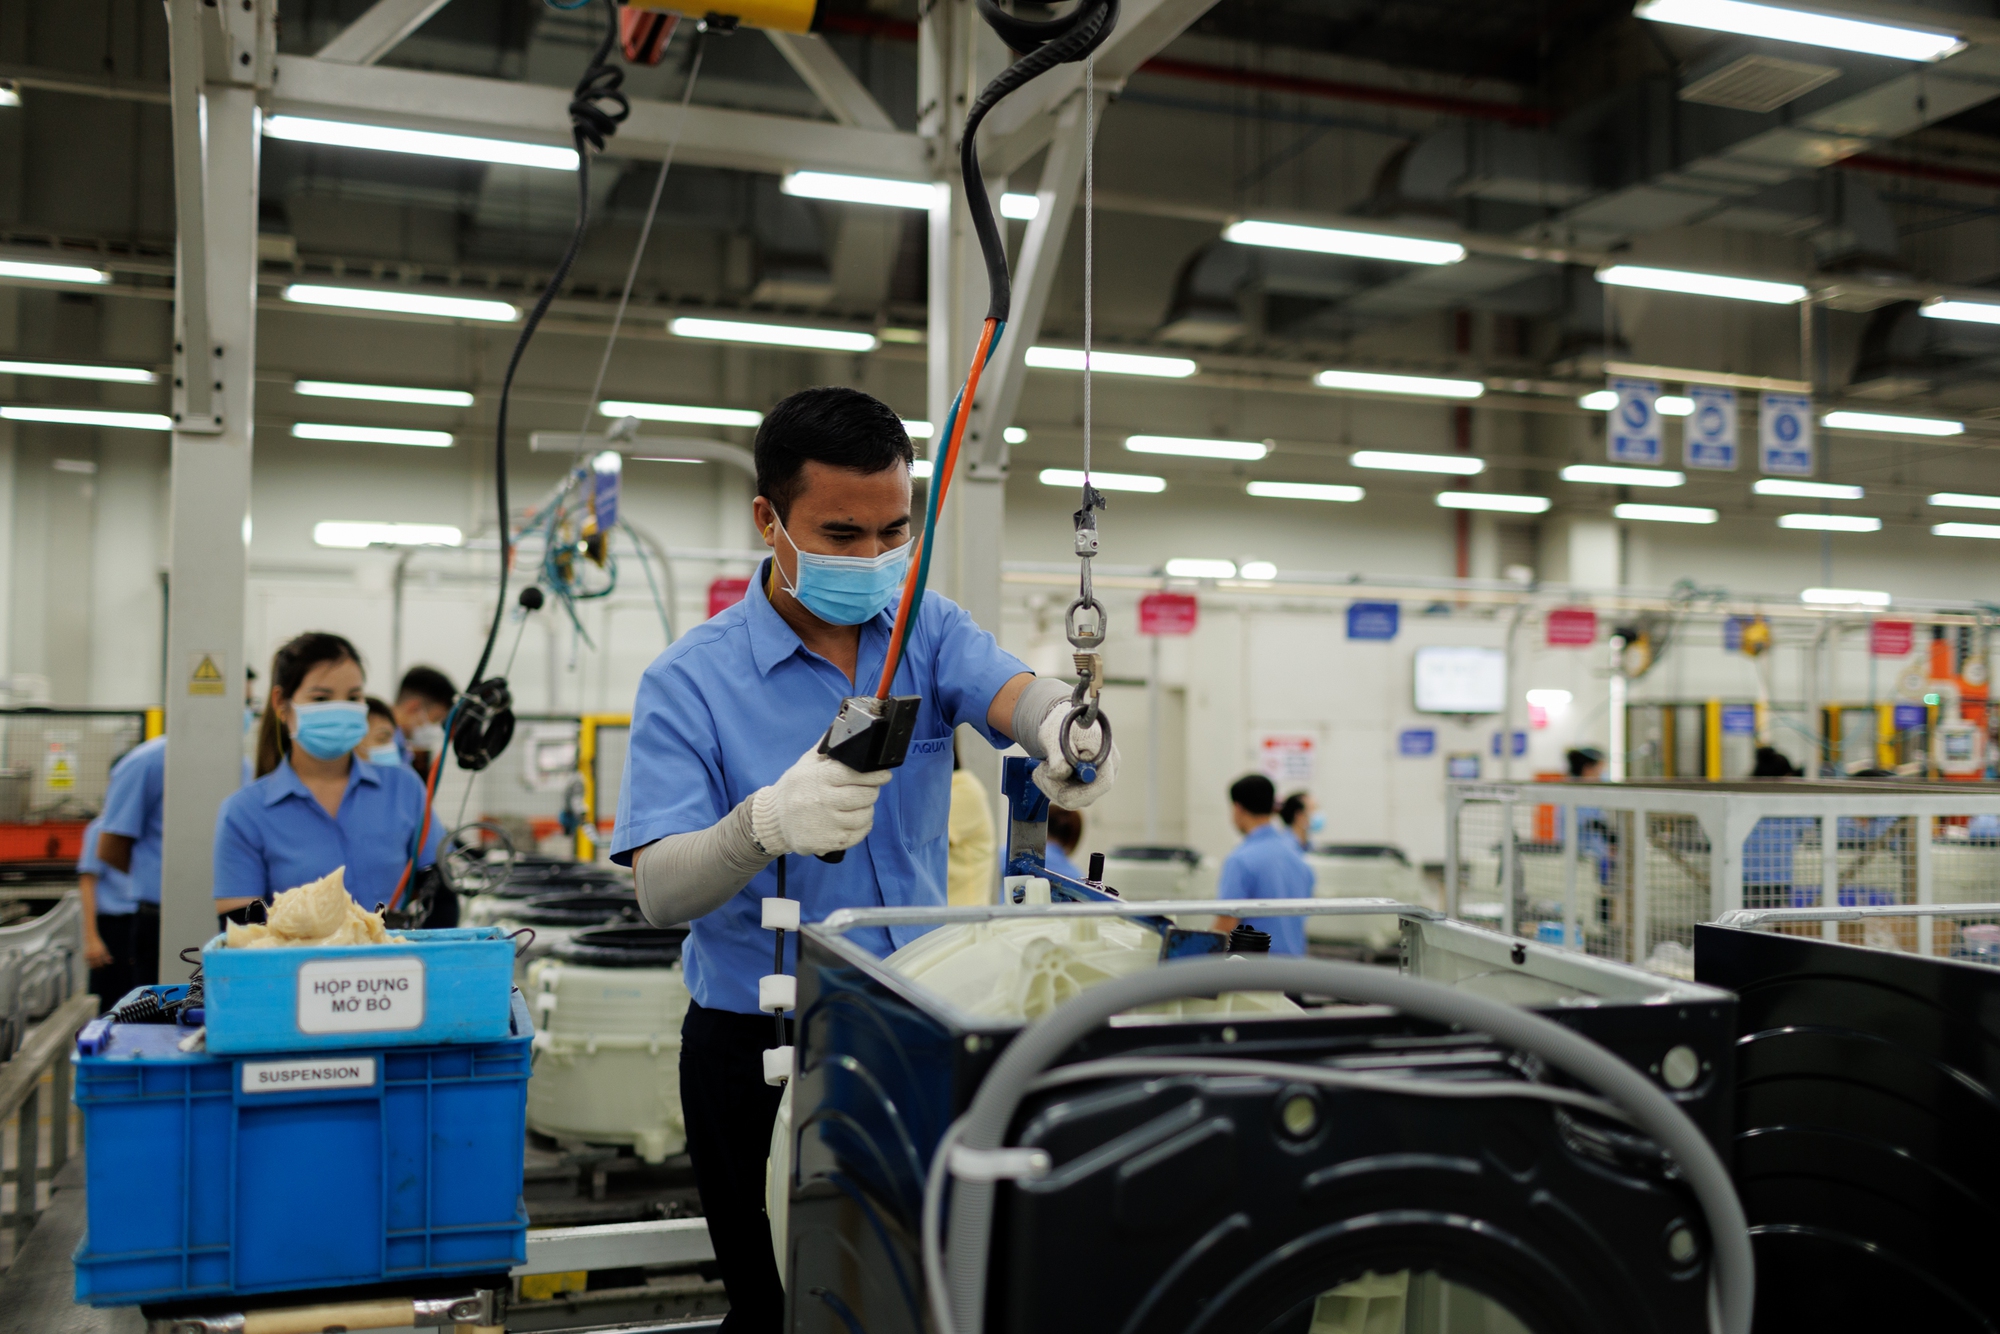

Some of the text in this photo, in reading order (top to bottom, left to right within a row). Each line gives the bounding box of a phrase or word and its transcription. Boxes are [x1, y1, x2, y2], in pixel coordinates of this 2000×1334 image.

[912, 741, 946, 754] AQUA
[357, 977, 409, 995] ĐỰNG
[259, 1066, 360, 1083] SUSPENSION
